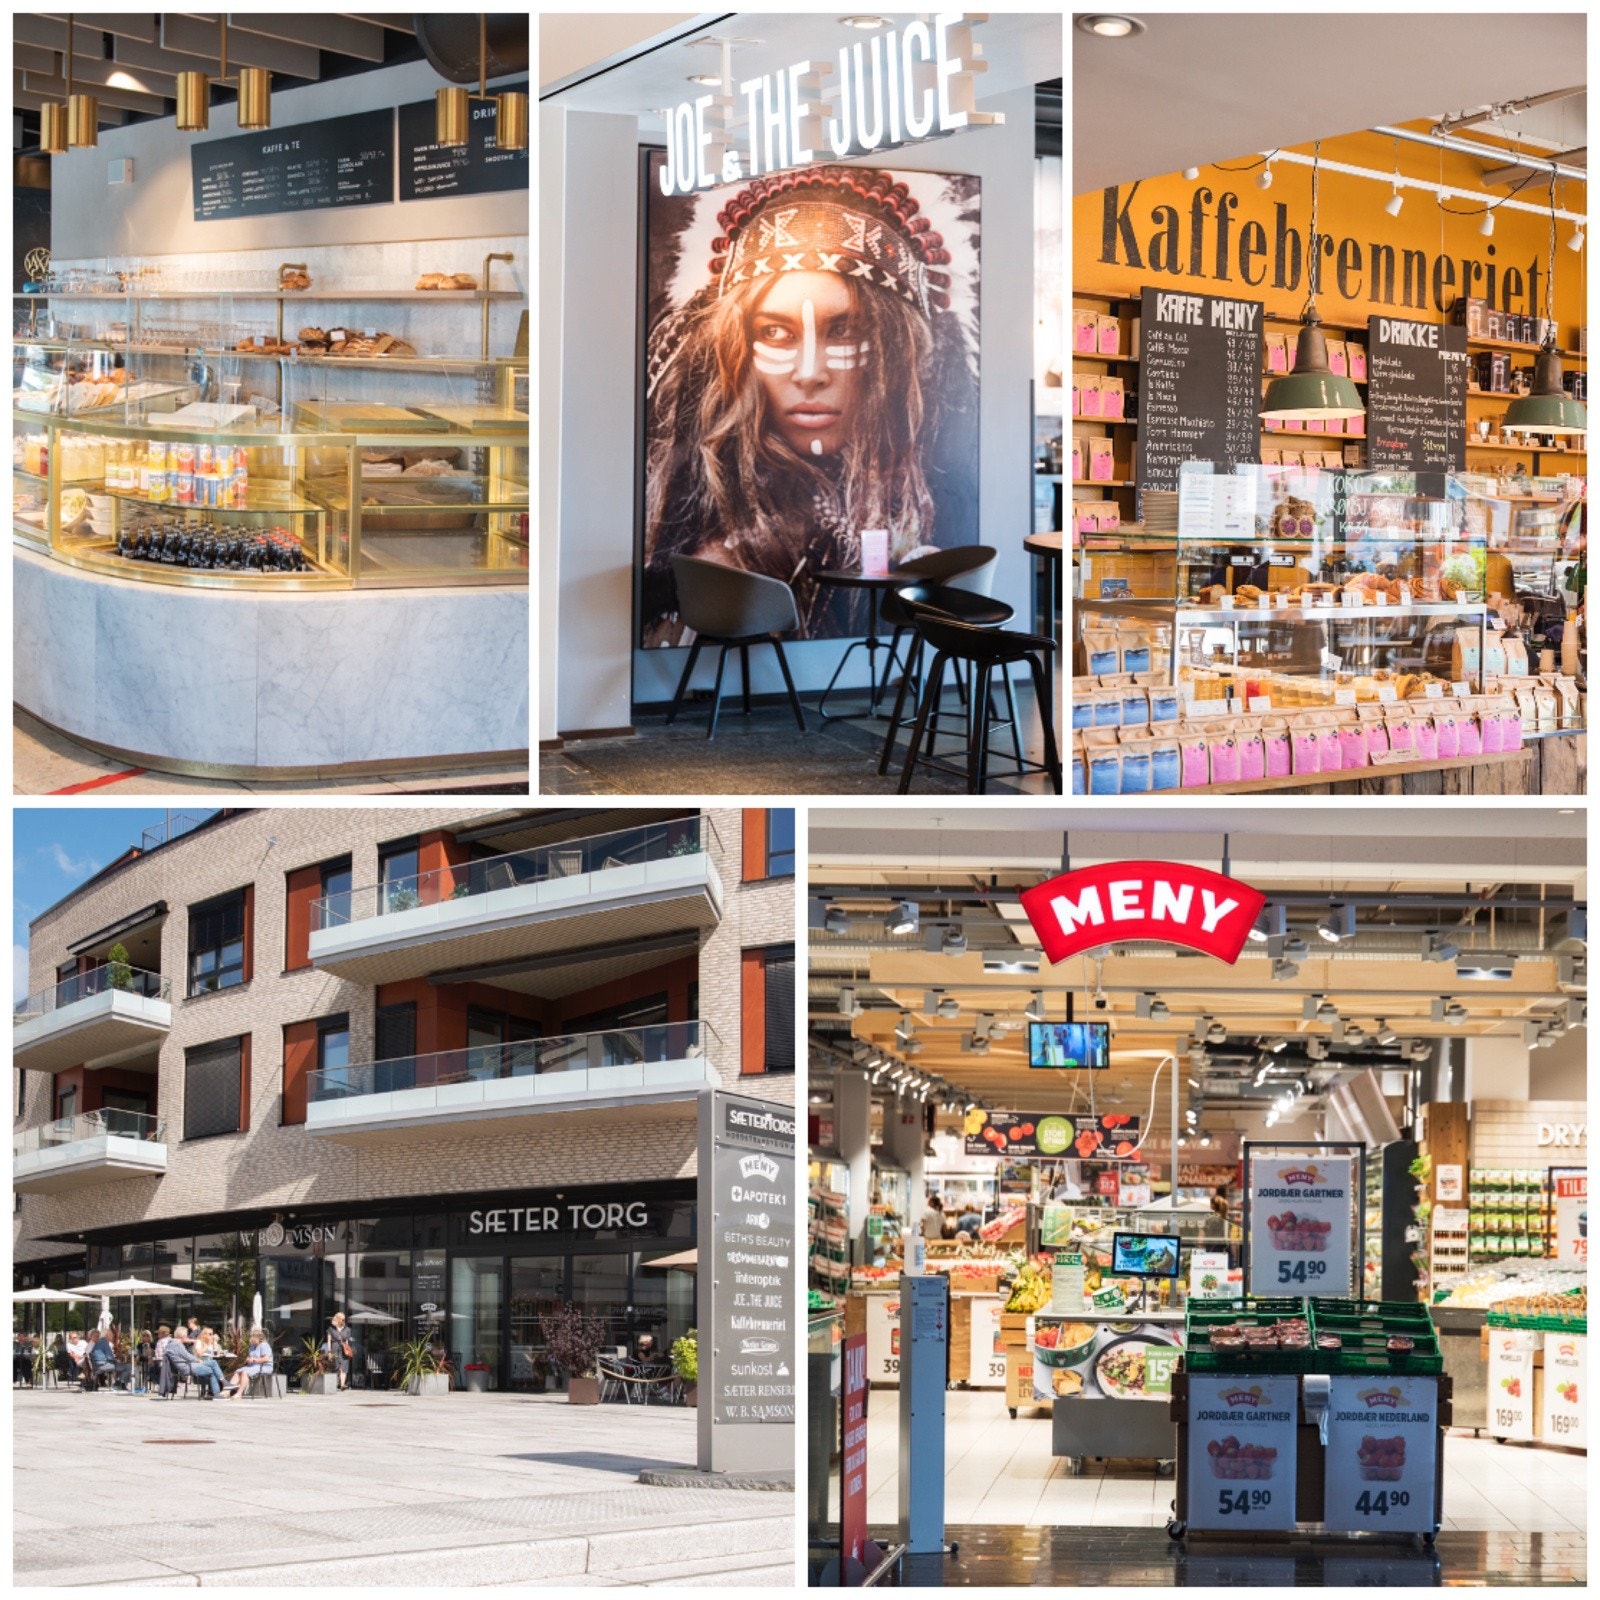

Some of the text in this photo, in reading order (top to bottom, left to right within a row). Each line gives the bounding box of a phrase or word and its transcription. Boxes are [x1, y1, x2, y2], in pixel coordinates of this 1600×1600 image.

[660, 13, 968, 196] JOE & THE JUICE
[262, 143, 283, 154] KAFFE
[291, 140, 300, 150] TE
[1097, 180, 1543, 318] Kaffebrenneriet
[1156, 292, 1259, 331] KAFFE MENY
[1379, 318, 1439, 349] DRIKKE
[1438, 350, 1468, 361] MENY
[1050, 879, 1240, 936] MENY
[744, 1158, 776, 1175] MENY
[1288, 1172, 1314, 1182] MENY
[1258, 1188, 1344, 1198] JORDBÆR GARTNER
[469, 1201, 648, 1234] SÆTER TORG
[724, 1231, 791, 1249] BETH'S BEAUTY
[750, 1293, 763, 1308] THE
[764, 1294, 783, 1309] JUICE
[731, 1314, 786, 1331] Kaffebrenneriet
[731, 1361, 773, 1376] sunkost
[724, 1384, 757, 1397] SÆTER
[1231, 1394, 1257, 1403] MENY
[725, 1405, 795, 1419] W. B. SAMSON
[1197, 1410, 1291, 1422] JORDBÆR GARTNER
[1335, 1411, 1430, 1423] JORDBÆR NEDERLAND
